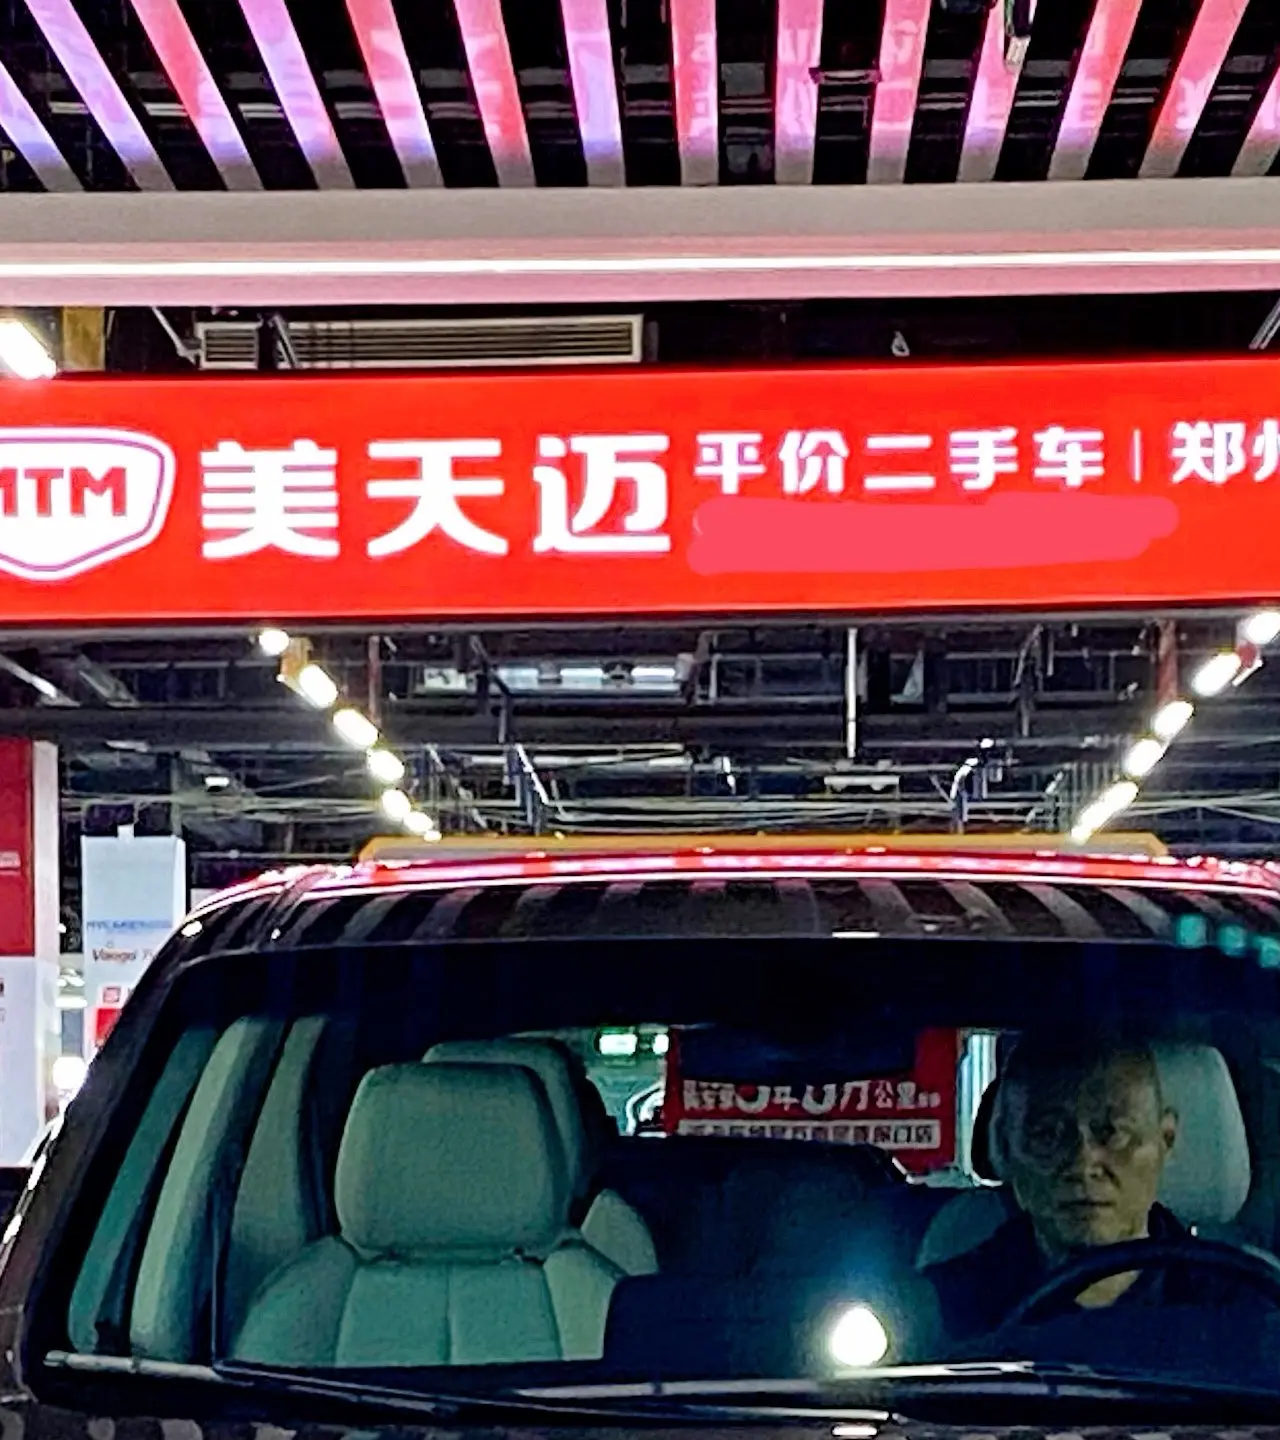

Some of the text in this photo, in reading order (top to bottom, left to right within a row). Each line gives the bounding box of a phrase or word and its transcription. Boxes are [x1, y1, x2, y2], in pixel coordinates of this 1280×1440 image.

[200, 435, 671, 560] 美天迈
[694, 425, 1106, 493] 平价二手车
